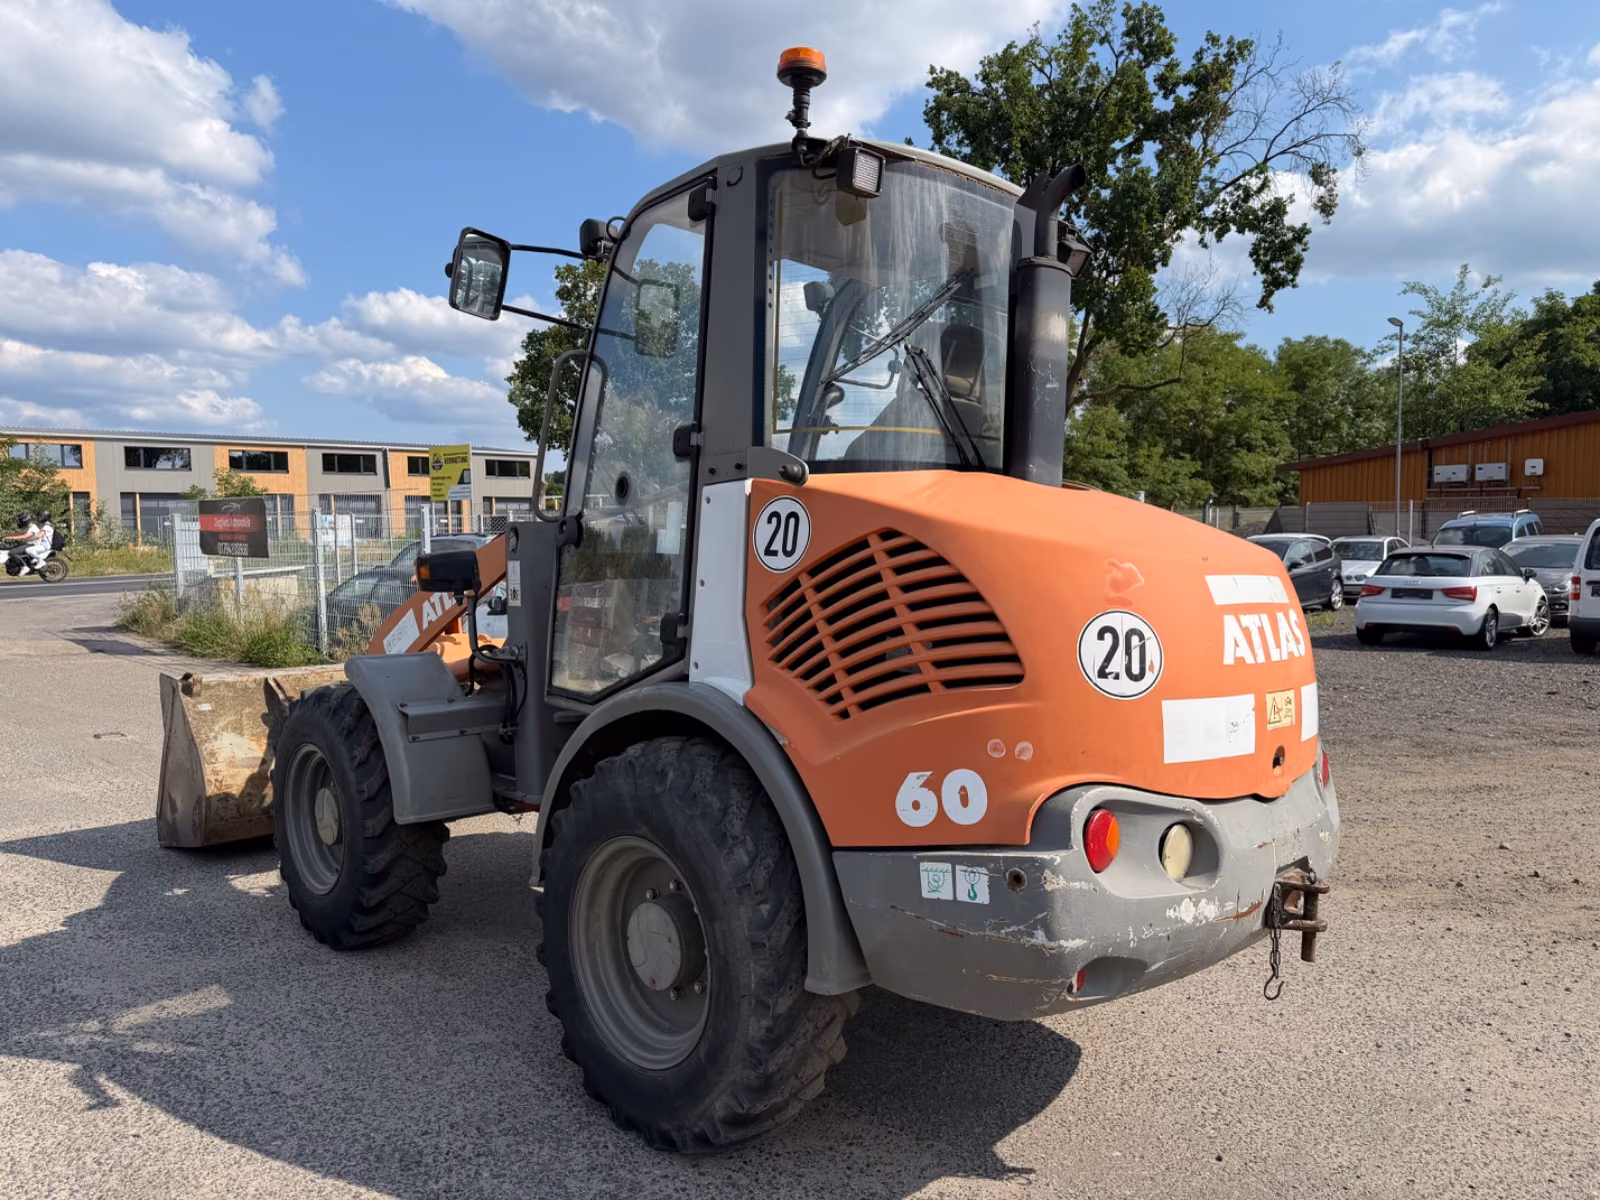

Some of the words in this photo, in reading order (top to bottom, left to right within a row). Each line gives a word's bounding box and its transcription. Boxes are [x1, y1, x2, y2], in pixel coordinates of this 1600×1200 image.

[764, 511, 800, 557] 20
[422, 591, 457, 631] ATL
[1223, 608, 1306, 665] ATLAS
[1096, 625, 1147, 682] 20
[895, 768, 988, 827] 60
